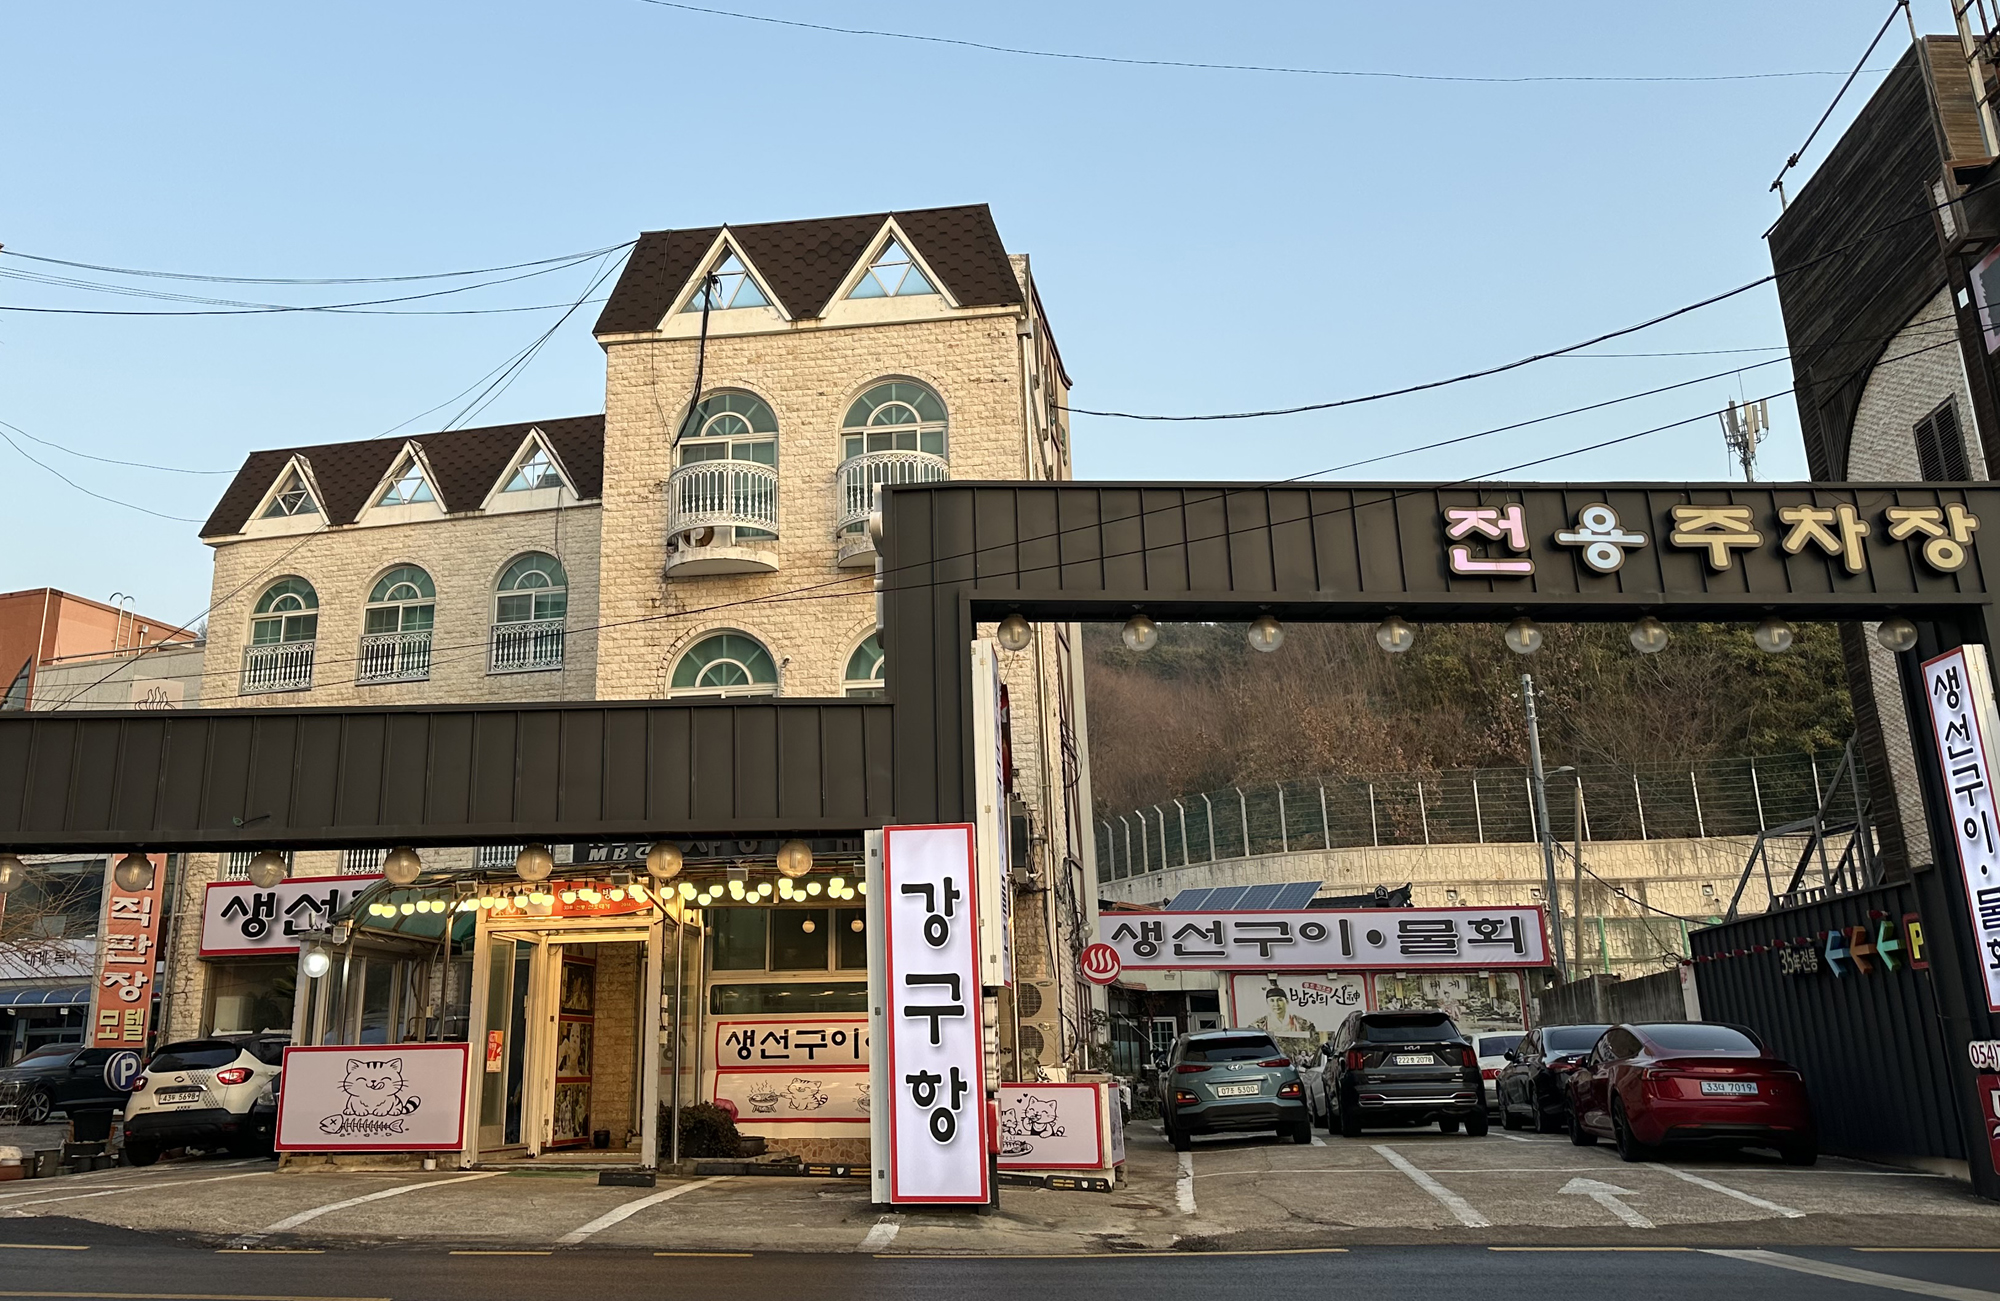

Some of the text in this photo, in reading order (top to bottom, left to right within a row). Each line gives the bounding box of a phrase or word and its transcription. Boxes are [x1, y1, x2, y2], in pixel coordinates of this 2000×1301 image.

[219, 887, 365, 939] 생선
[102, 860, 155, 1001] 직판장
[1909, 922, 1924, 960] P
[901, 877, 968, 1143] 강구항
[1289, 987, 1328, 1007] 밥상의
[97, 1008, 145, 1042] 모텔
[120, 1057, 137, 1086] P
[1970, 1044, 2000, 1071] 054)
[178, 1092, 196, 1101] 5698
[1237, 1086, 1255, 1094] 5300
[1728, 1083, 1752, 1092] 7019
